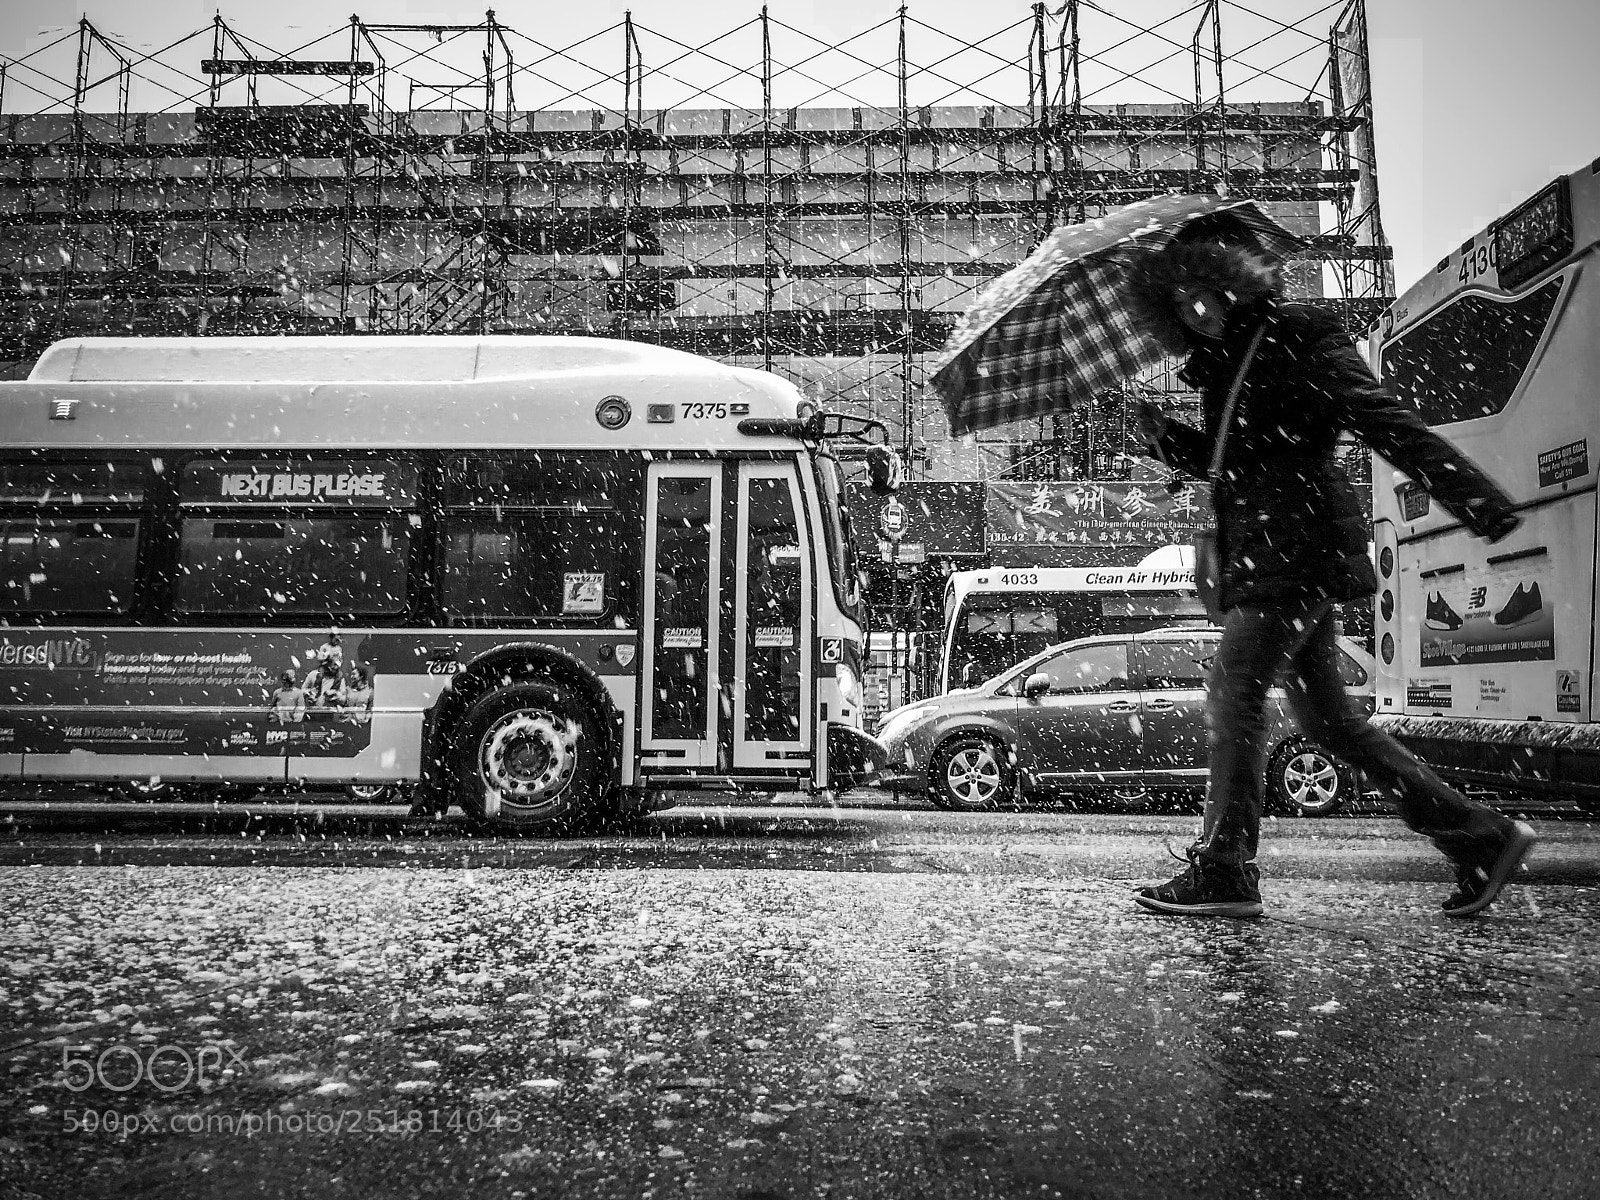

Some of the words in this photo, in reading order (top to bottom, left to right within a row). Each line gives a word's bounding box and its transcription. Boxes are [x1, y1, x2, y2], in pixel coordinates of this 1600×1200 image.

[681, 403, 727, 419] 7375
[221, 474, 271, 496] NEXT
[272, 474, 311, 496] BUS
[313, 474, 385, 496] PLEASE
[1001, 573, 1038, 586] 4033
[1085, 572, 1123, 585] Clean
[1127, 572, 1148, 585] Air
[664, 627, 702, 636] CAUTION
[755, 626, 793, 636] CAUTION
[104, 651, 125, 664] Sign
[126, 655, 139, 664] up
[139, 653, 152, 662] for
[174, 655, 185, 663] or
[221, 653, 252, 663] health
[103, 663, 151, 673] insurance
[177, 664, 196, 673] and
[425, 660, 457, 673] 7375
[129, 675, 147, 684] and
[147, 675, 205, 686] prescription
[205, 676, 233, 687] drugs
